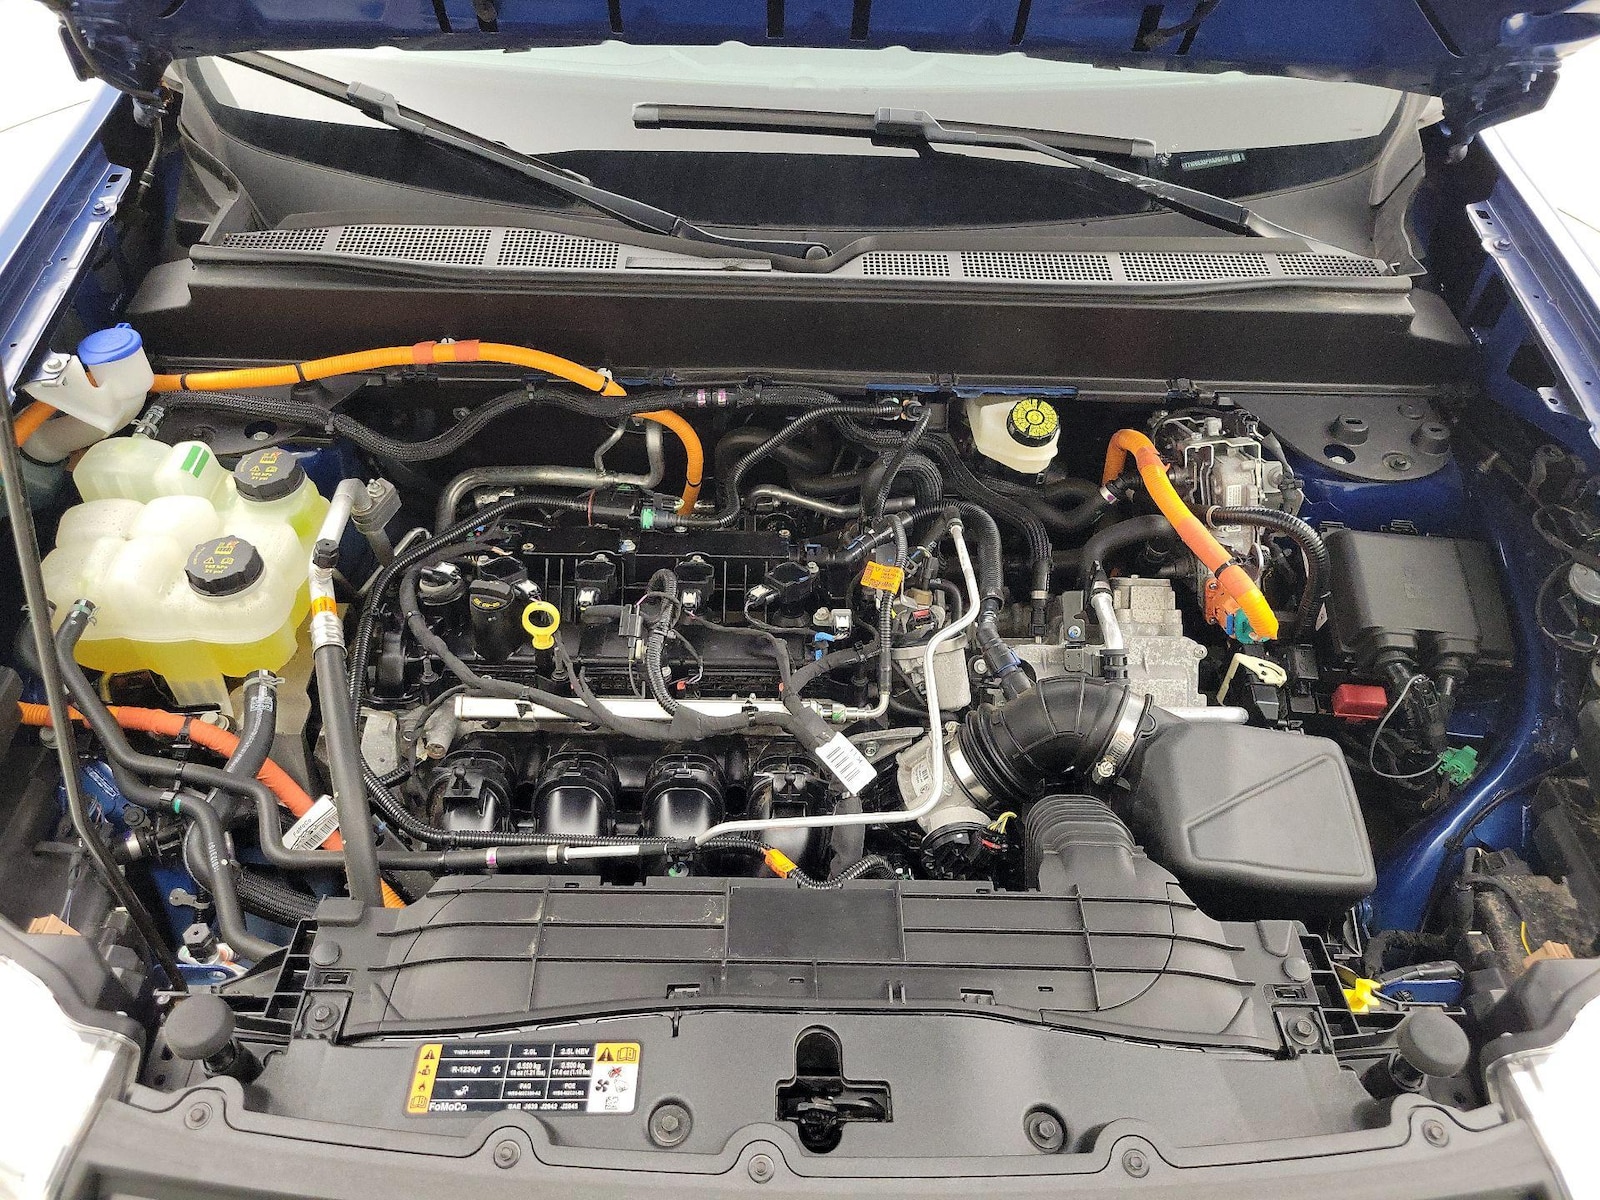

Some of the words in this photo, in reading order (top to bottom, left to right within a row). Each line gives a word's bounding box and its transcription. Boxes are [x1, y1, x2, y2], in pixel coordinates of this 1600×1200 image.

[575, 1047, 590, 1055] HEV
[451, 1065, 482, 1075] R-1234yf
[429, 1102, 468, 1112] FoMoCo
